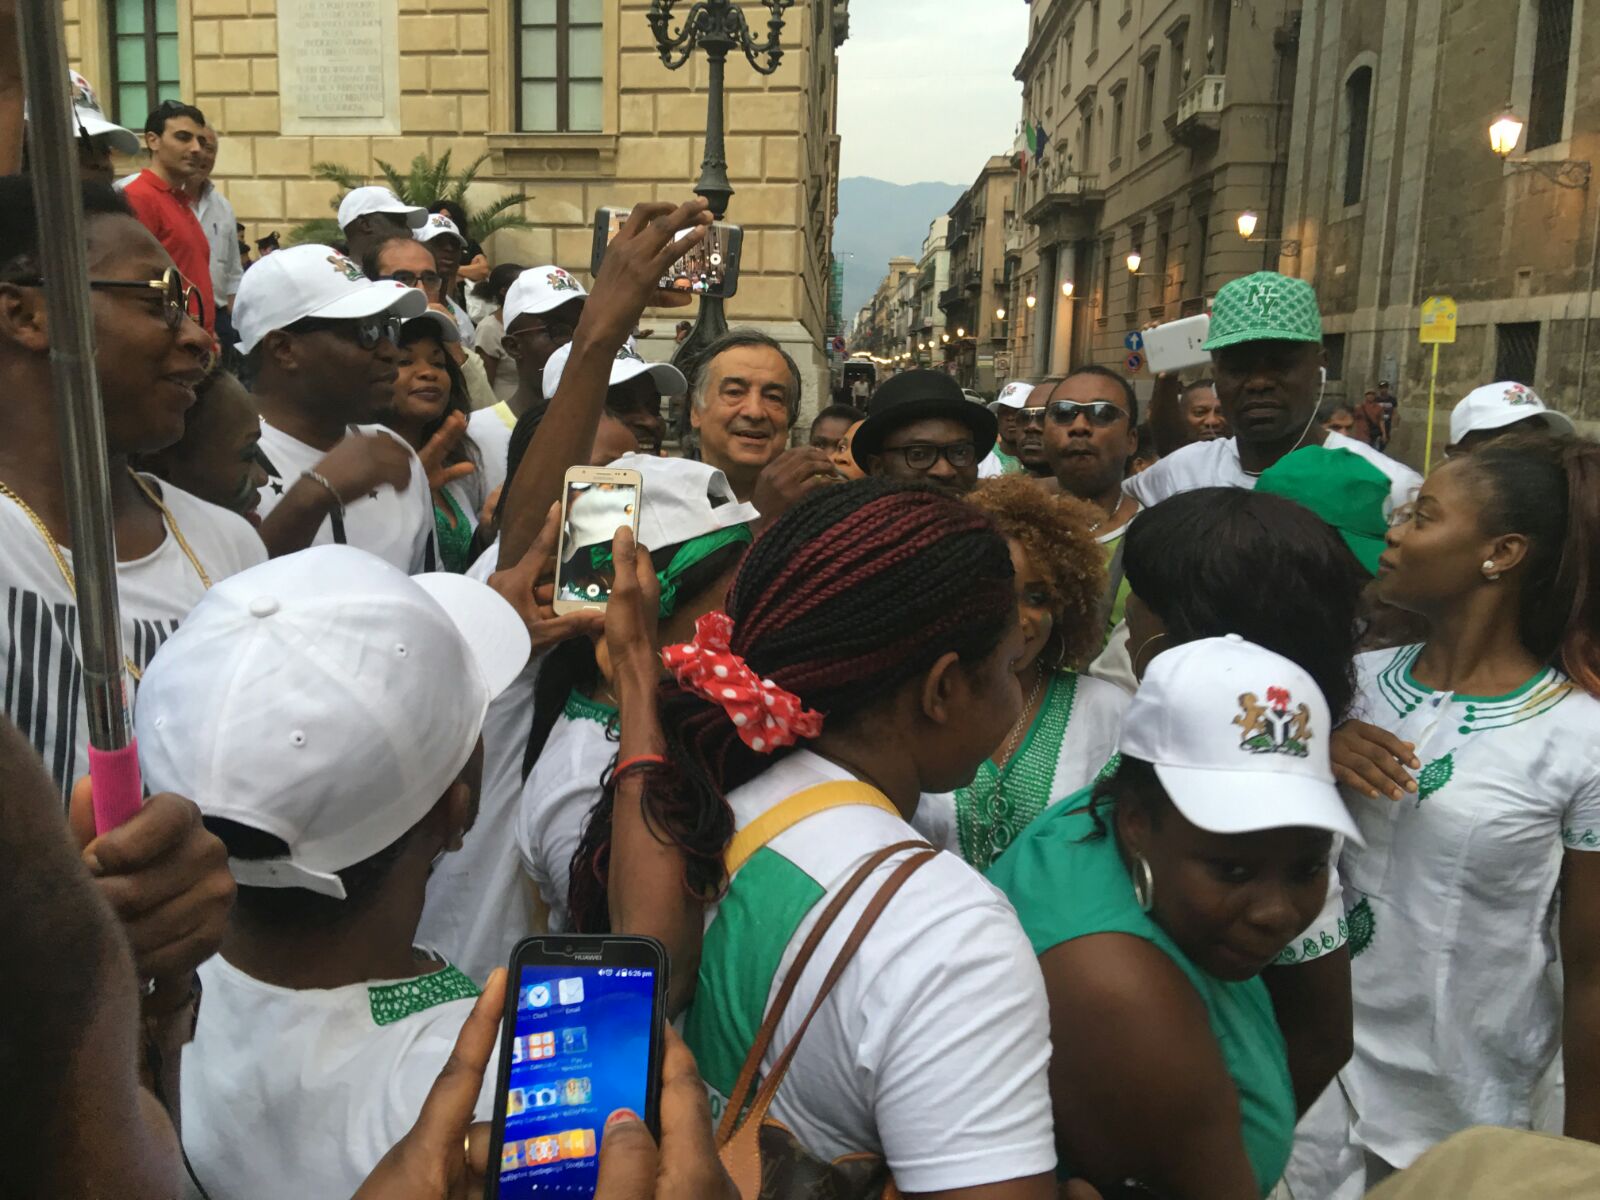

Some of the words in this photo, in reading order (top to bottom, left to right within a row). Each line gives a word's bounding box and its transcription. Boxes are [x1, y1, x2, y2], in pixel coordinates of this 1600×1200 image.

[1245, 284, 1278, 317] NY
[642, 971, 652, 979] pm
[565, 1006, 581, 1015] Email
[532, 1012, 548, 1020] Clock
